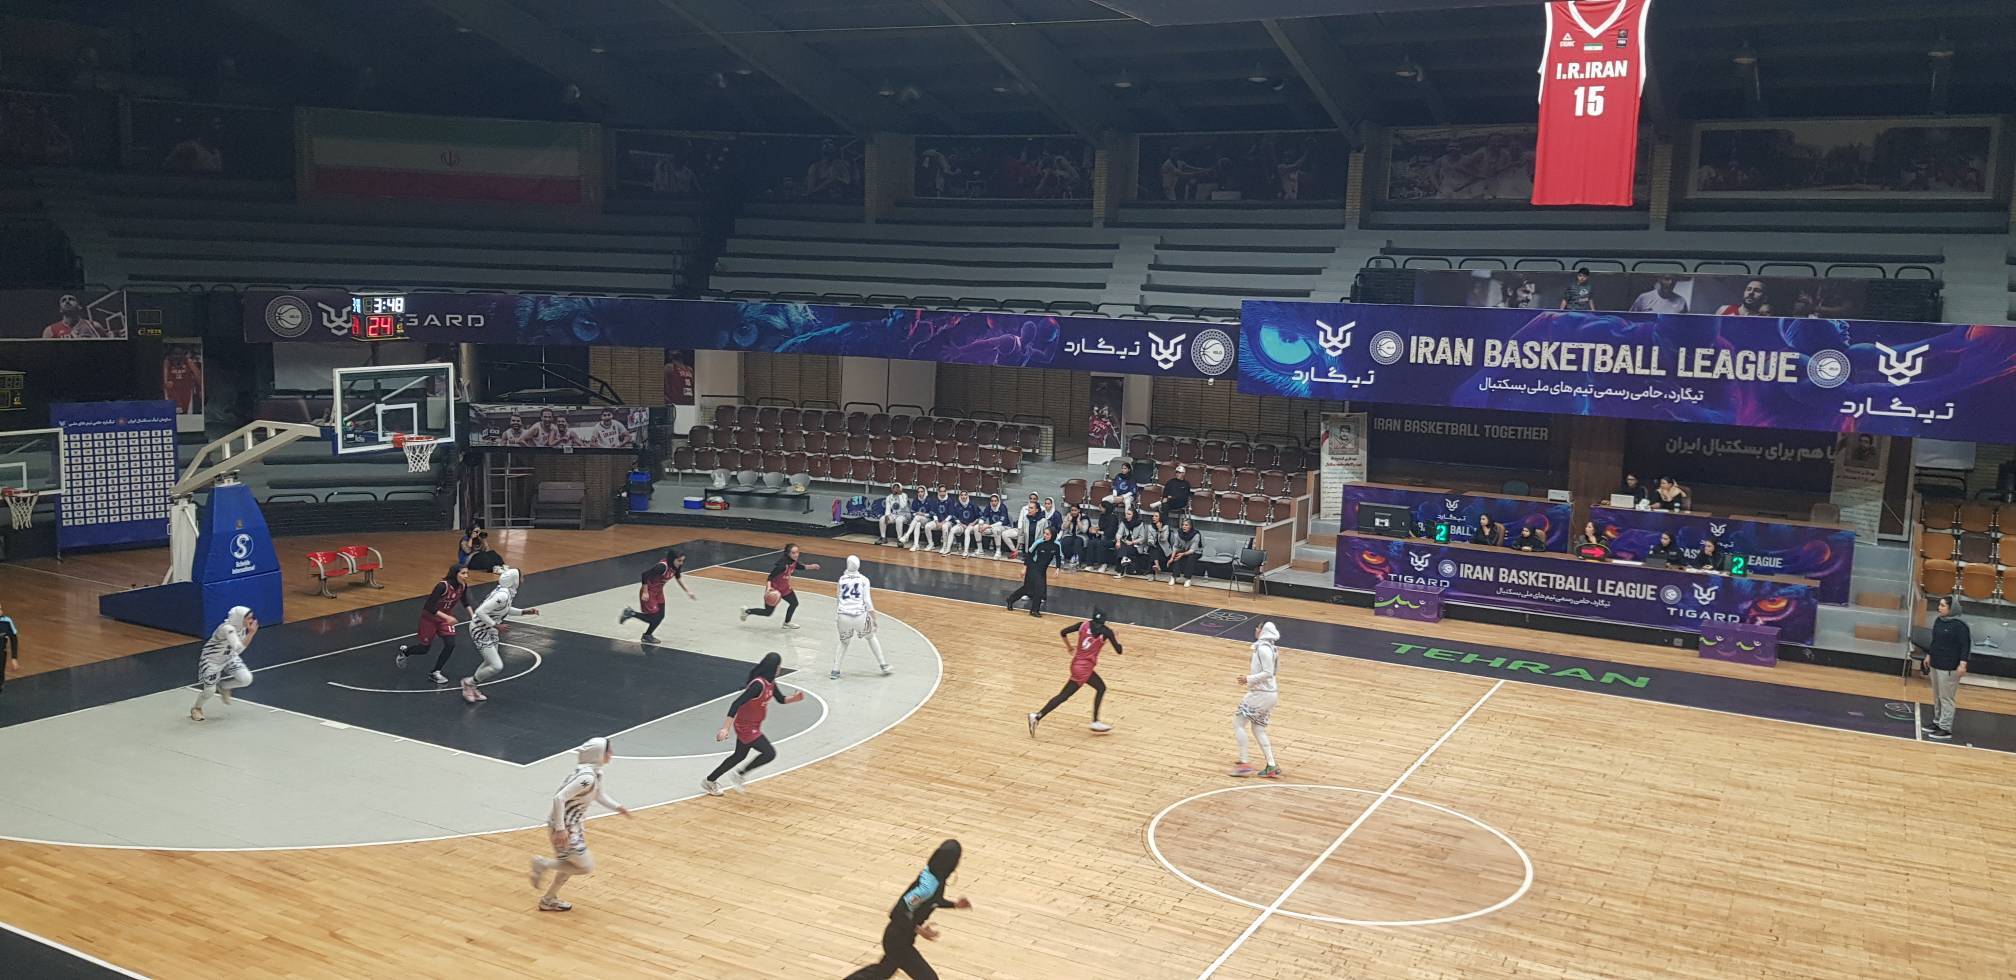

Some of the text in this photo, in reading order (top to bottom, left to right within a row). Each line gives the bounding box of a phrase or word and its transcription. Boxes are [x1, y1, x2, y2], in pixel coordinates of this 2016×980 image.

[1556, 60, 1628, 80] I.R.IRAN
[1574, 86, 1605, 117] 15
[373, 297, 404, 313] 3:48
[368, 317, 391, 336] 24
[405, 314, 484, 326] GARD
[1064, 338, 1140, 360] تیگارد
[1409, 336, 1800, 383] IRAN BASKETBALL LEAGUE
[1292, 366, 1375, 388] تیگارد
[1478, 377, 1527, 392] بسکتبال
[1527, 379, 1549, 395] ملی
[1594, 385, 1630, 400] رسمی
[1630, 386, 1663, 402] حامی
[1840, 396, 1954, 424] تیگارد
[1374, 417, 1549, 441] IRAN BASKETBALL TOGETHER
[1665, 436, 1700, 453] ایران
[1703, 438, 1763, 458] بسکتبال
[1765, 443, 1794, 461] برای
[1795, 446, 1823, 462] هم
[1435, 524, 1447, 541] 2
[1731, 556, 1744, 574] 2
[1748, 555, 1783, 568] EAGUE
[1388, 573, 1449, 588] TIGARD
[1460, 563, 1658, 601] IRAN BASKETBALL LEAGUE
[841, 583, 861, 600] 24
[1667, 607, 1740, 623] TIGARD
[1392, 642, 1650, 689] TEHRAN
